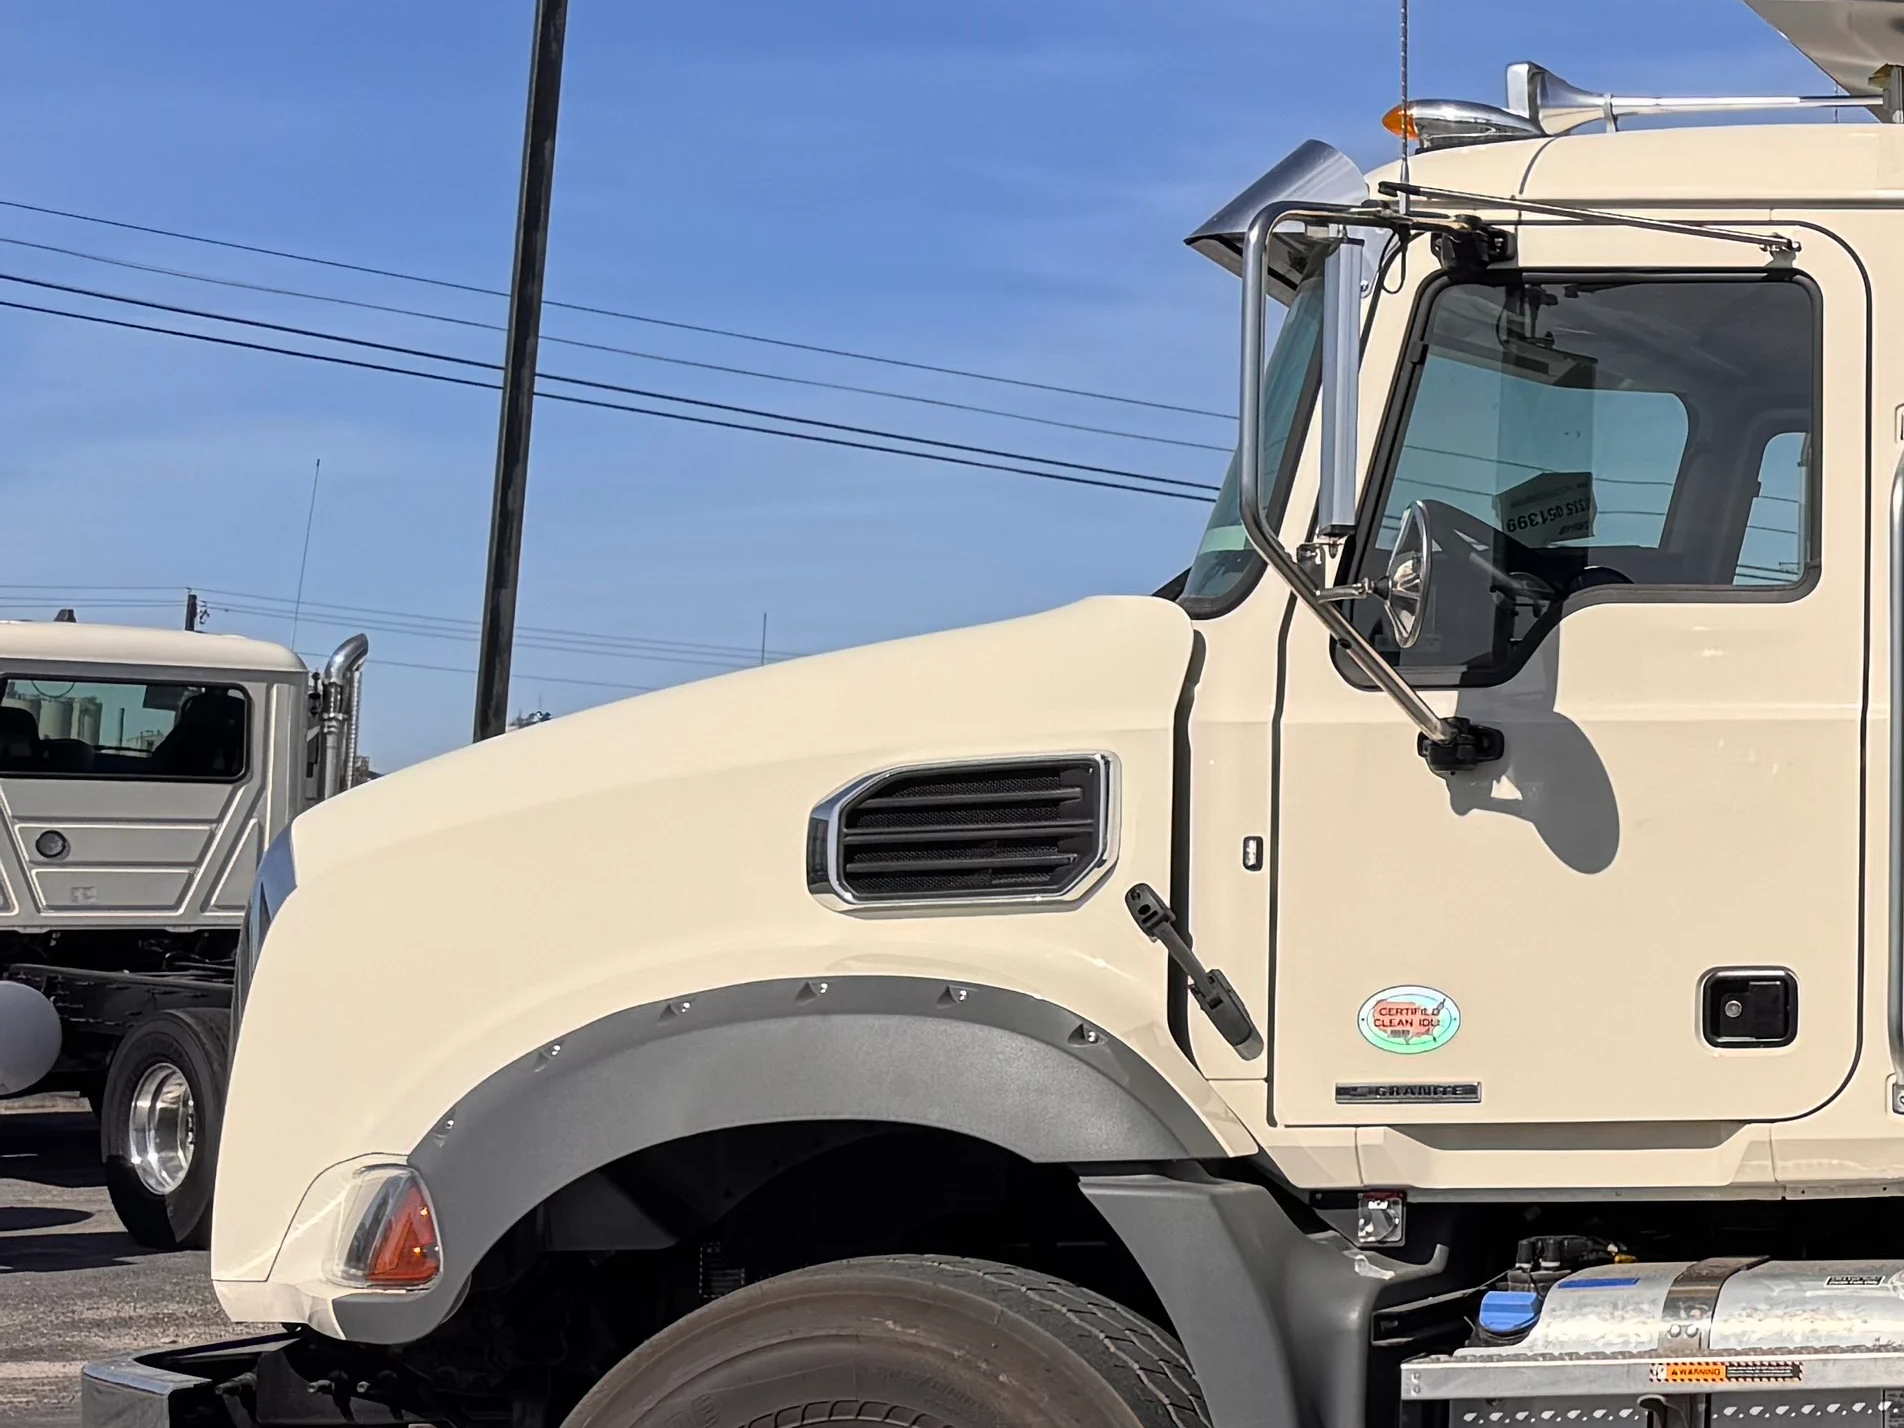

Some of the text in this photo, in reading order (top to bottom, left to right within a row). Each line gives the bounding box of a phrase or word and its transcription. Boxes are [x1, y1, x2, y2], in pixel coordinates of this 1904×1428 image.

[1374, 1018, 1413, 1027] CLEAN
[1377, 1084, 1464, 1096] GRANITE
[1680, 1368, 1721, 1376] WARNING
